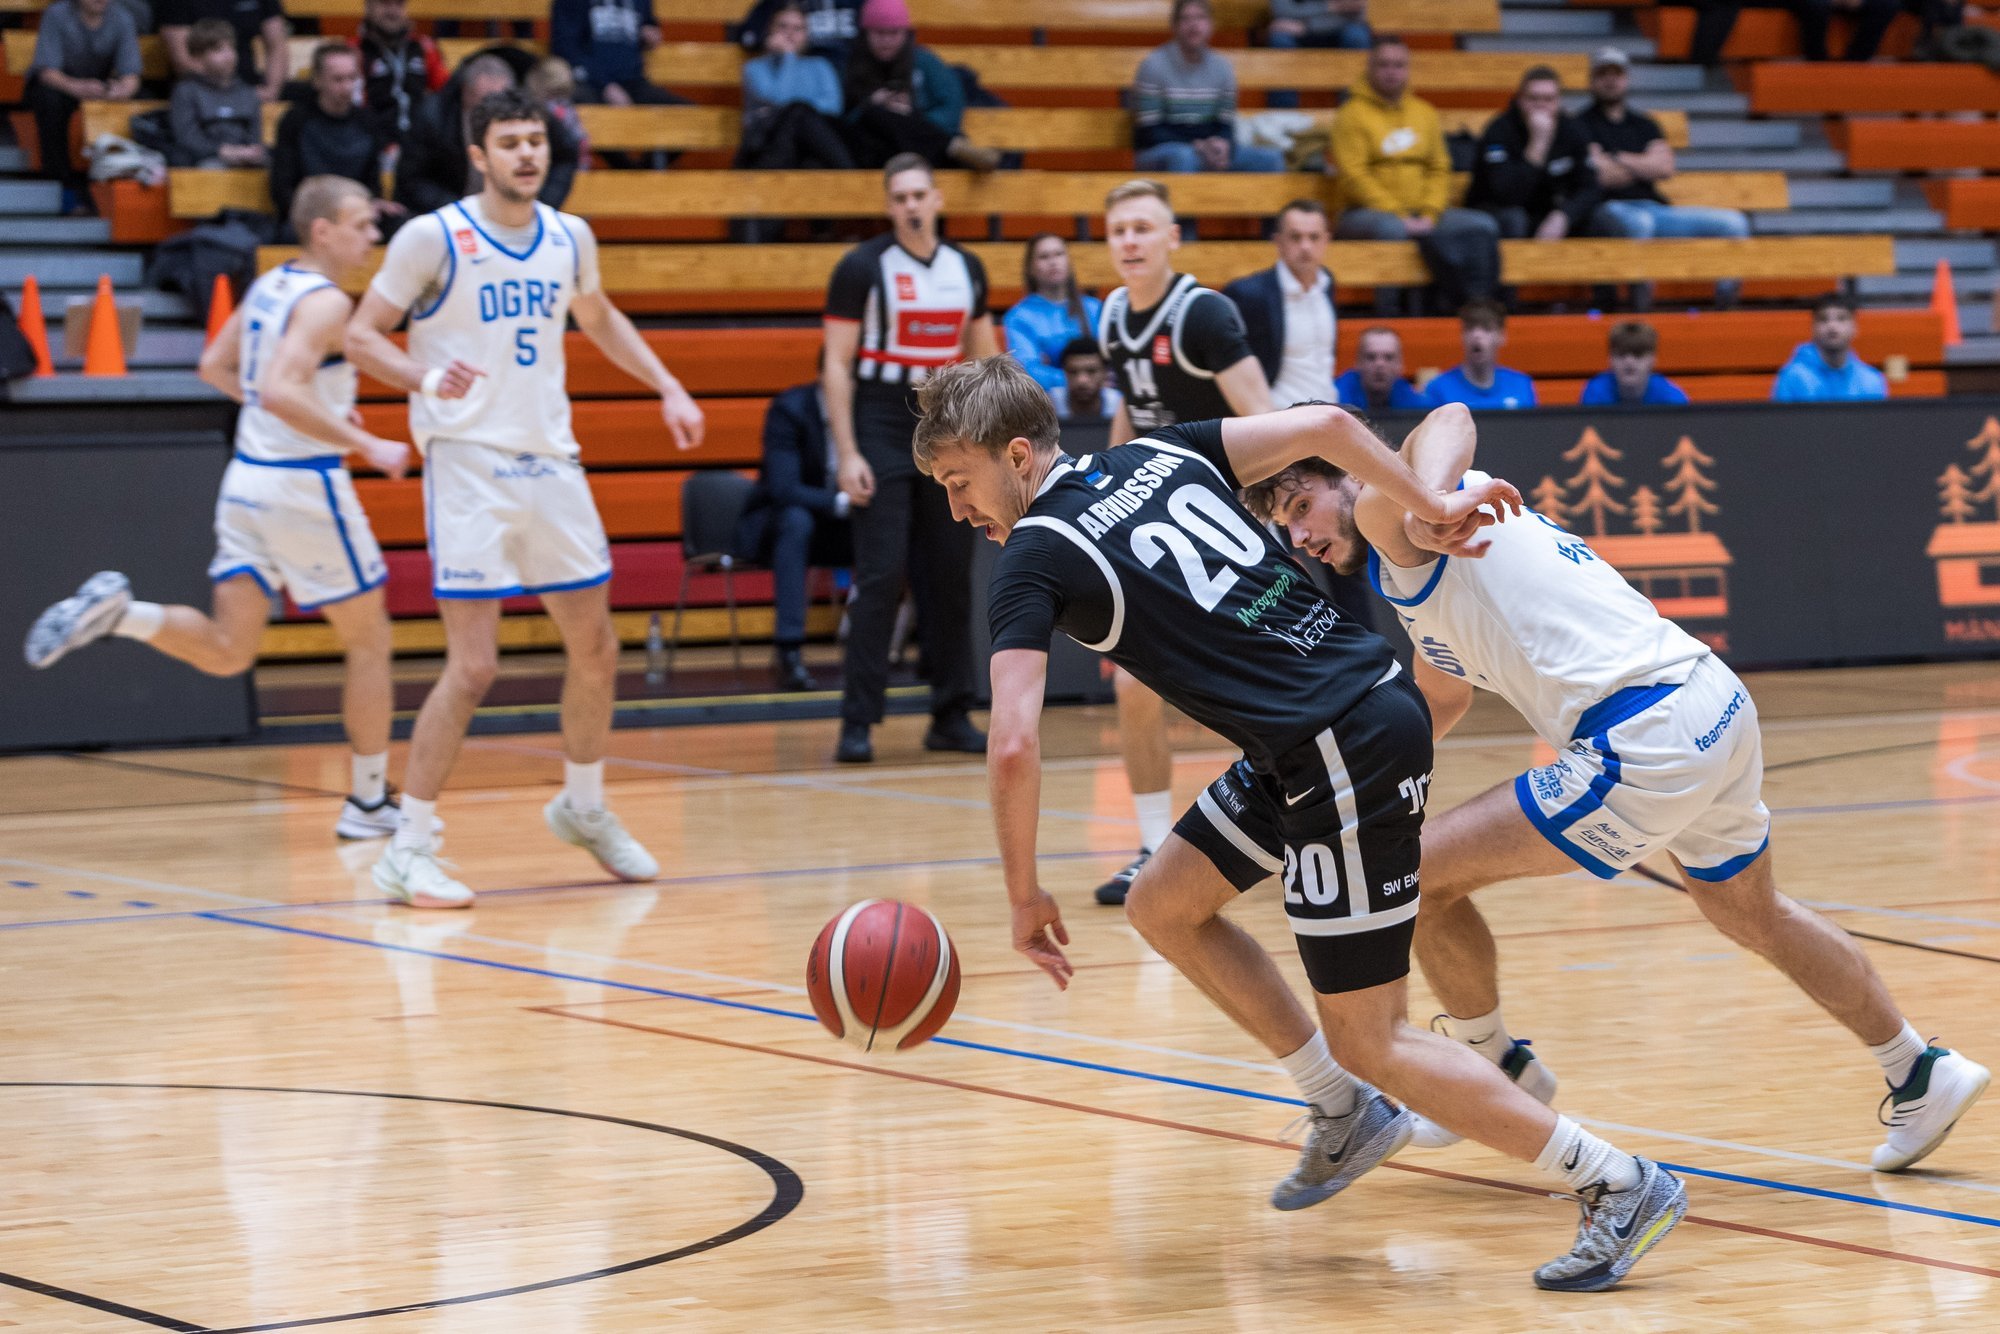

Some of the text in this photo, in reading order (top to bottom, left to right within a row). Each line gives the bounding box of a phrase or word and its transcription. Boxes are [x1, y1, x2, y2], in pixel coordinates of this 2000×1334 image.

[514, 326, 538, 367] 5
[1076, 452, 1185, 541] ARVIDSSON
[1130, 483, 1266, 613] 20
[1229, 792, 1245, 813] Vesi
[1284, 842, 1340, 906] 20
[1383, 878, 1402, 896] SW
